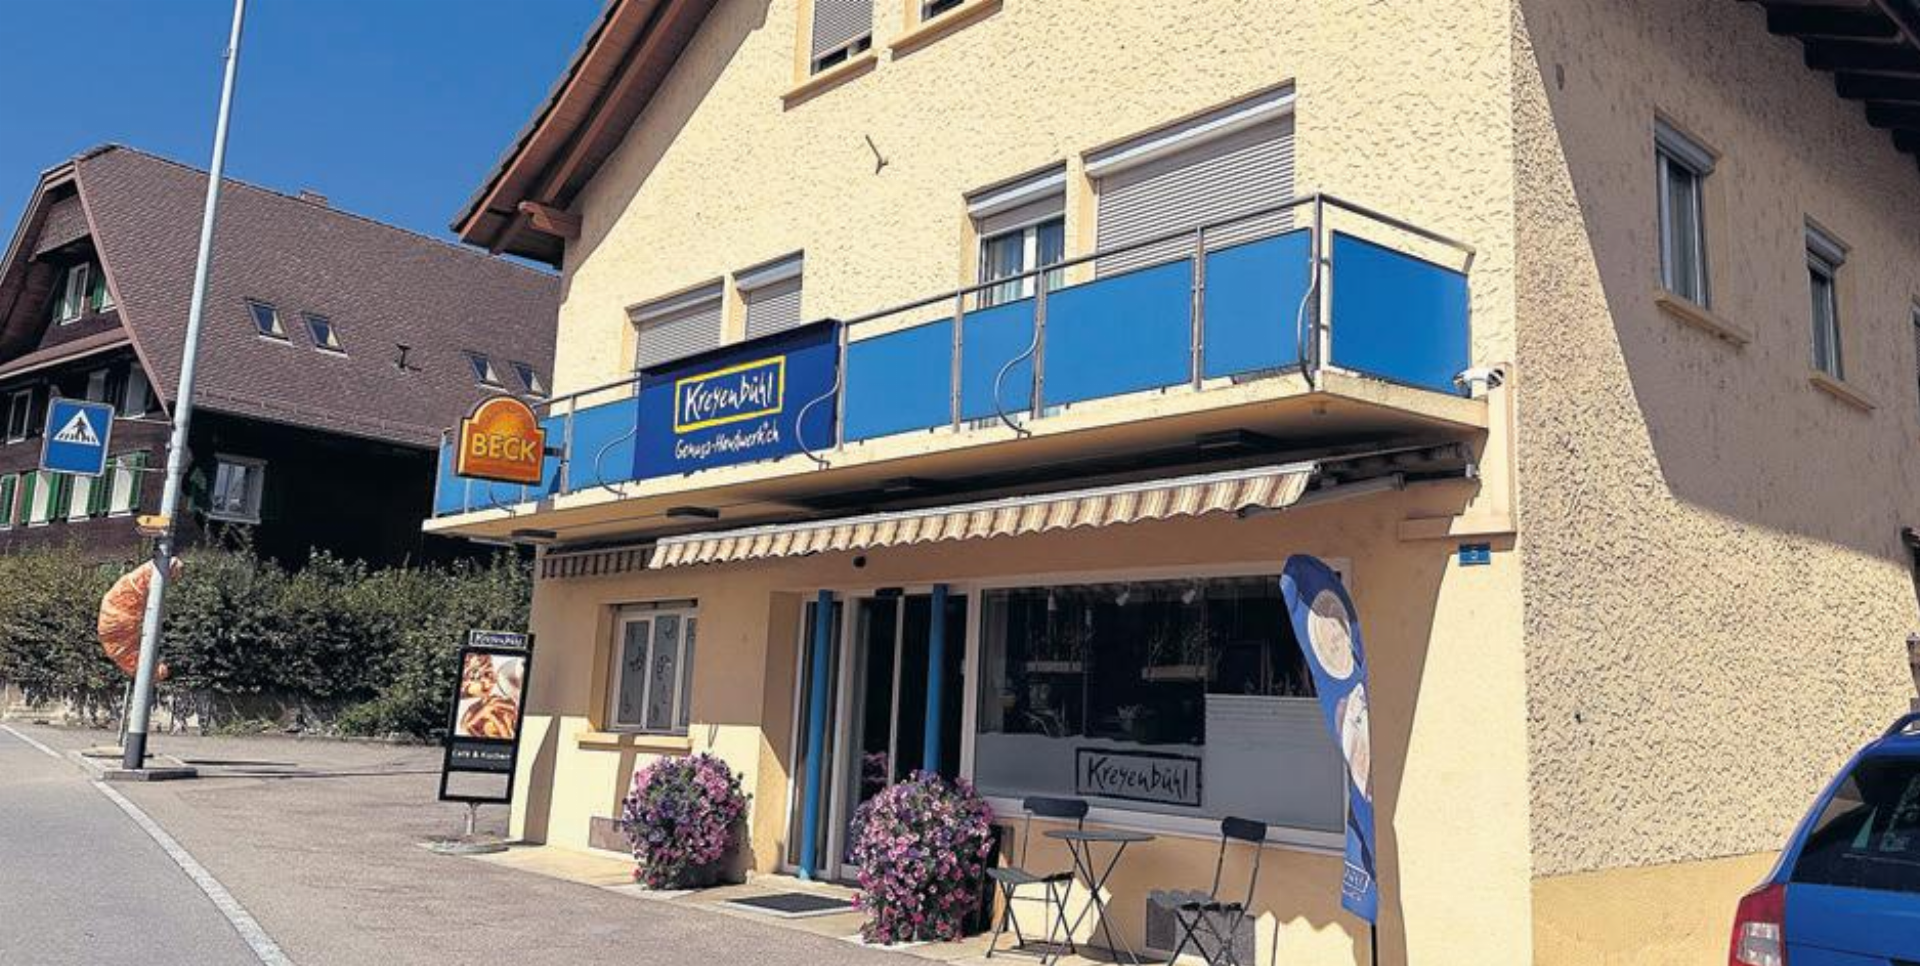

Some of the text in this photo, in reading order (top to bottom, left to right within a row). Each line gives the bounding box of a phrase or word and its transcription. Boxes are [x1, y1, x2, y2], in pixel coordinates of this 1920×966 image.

[684, 371, 773, 422] Kreyenbühl
[472, 433, 537, 462] BECK
[1088, 757, 1188, 800] Kreyenbühl
